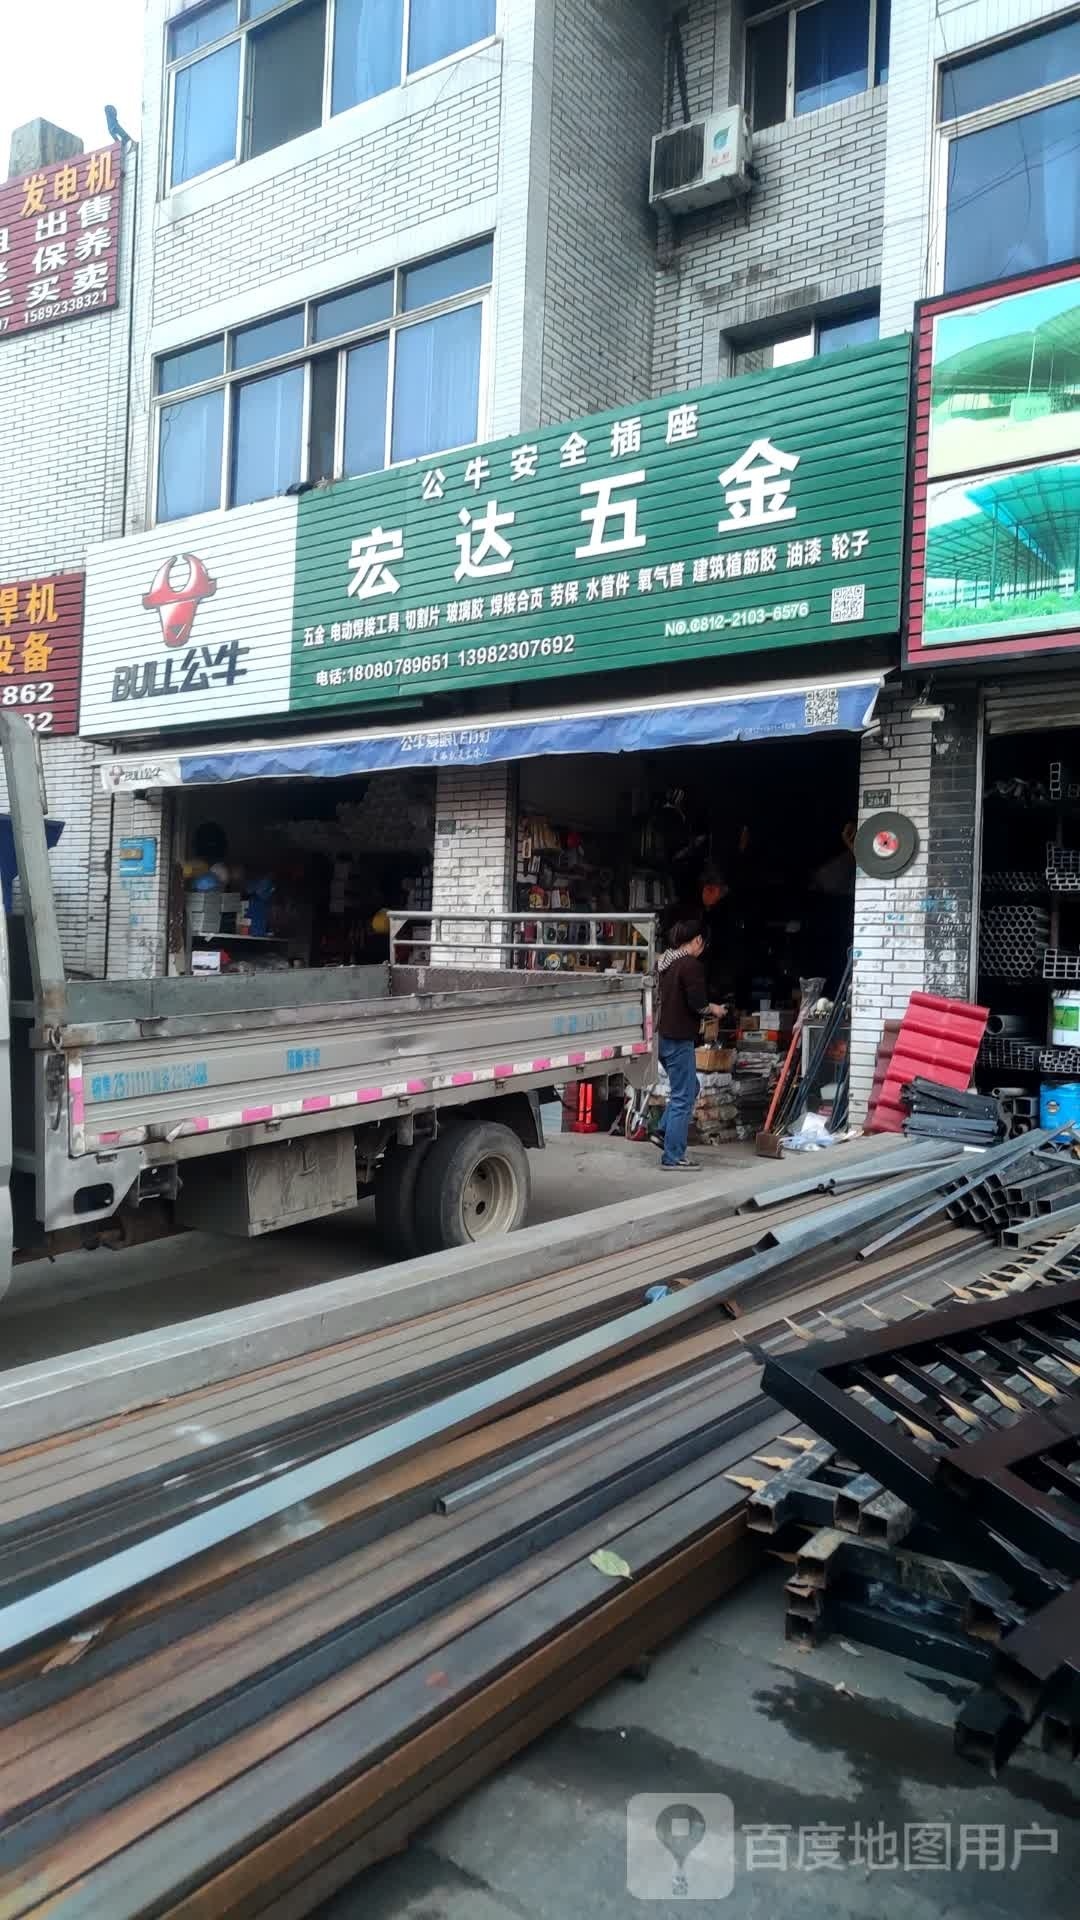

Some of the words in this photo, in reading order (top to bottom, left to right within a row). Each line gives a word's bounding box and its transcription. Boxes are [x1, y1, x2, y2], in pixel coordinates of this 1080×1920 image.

[19, 151, 117, 218] 发电机
[35, 195, 112, 242] 出售
[31, 226, 113, 274] 保养
[23, 289, 108, 324] 15892338321
[25, 263, 110, 308] 买卖
[421, 403, 698, 501] 公牛安全插座
[347, 437, 801, 601] 宏达五金
[303, 624, 325, 647] 五金
[330, 611, 399, 640] 电动焊接工具
[405, 605, 440, 631] 切割片
[446, 598, 484, 624] 玻璃胶
[490, 587, 544, 617] 焊接合页
[551, 581, 579, 608] 劳保
[586, 571, 630, 601] 水管件
[693, 546, 777, 583] 建筑植筋胶
[786, 537, 822, 568] 油漆
[831, 529, 869, 560] 轮子
[316, 652, 449, 687] 电话:18080789651
[458, 634, 575, 668] 13982307692
